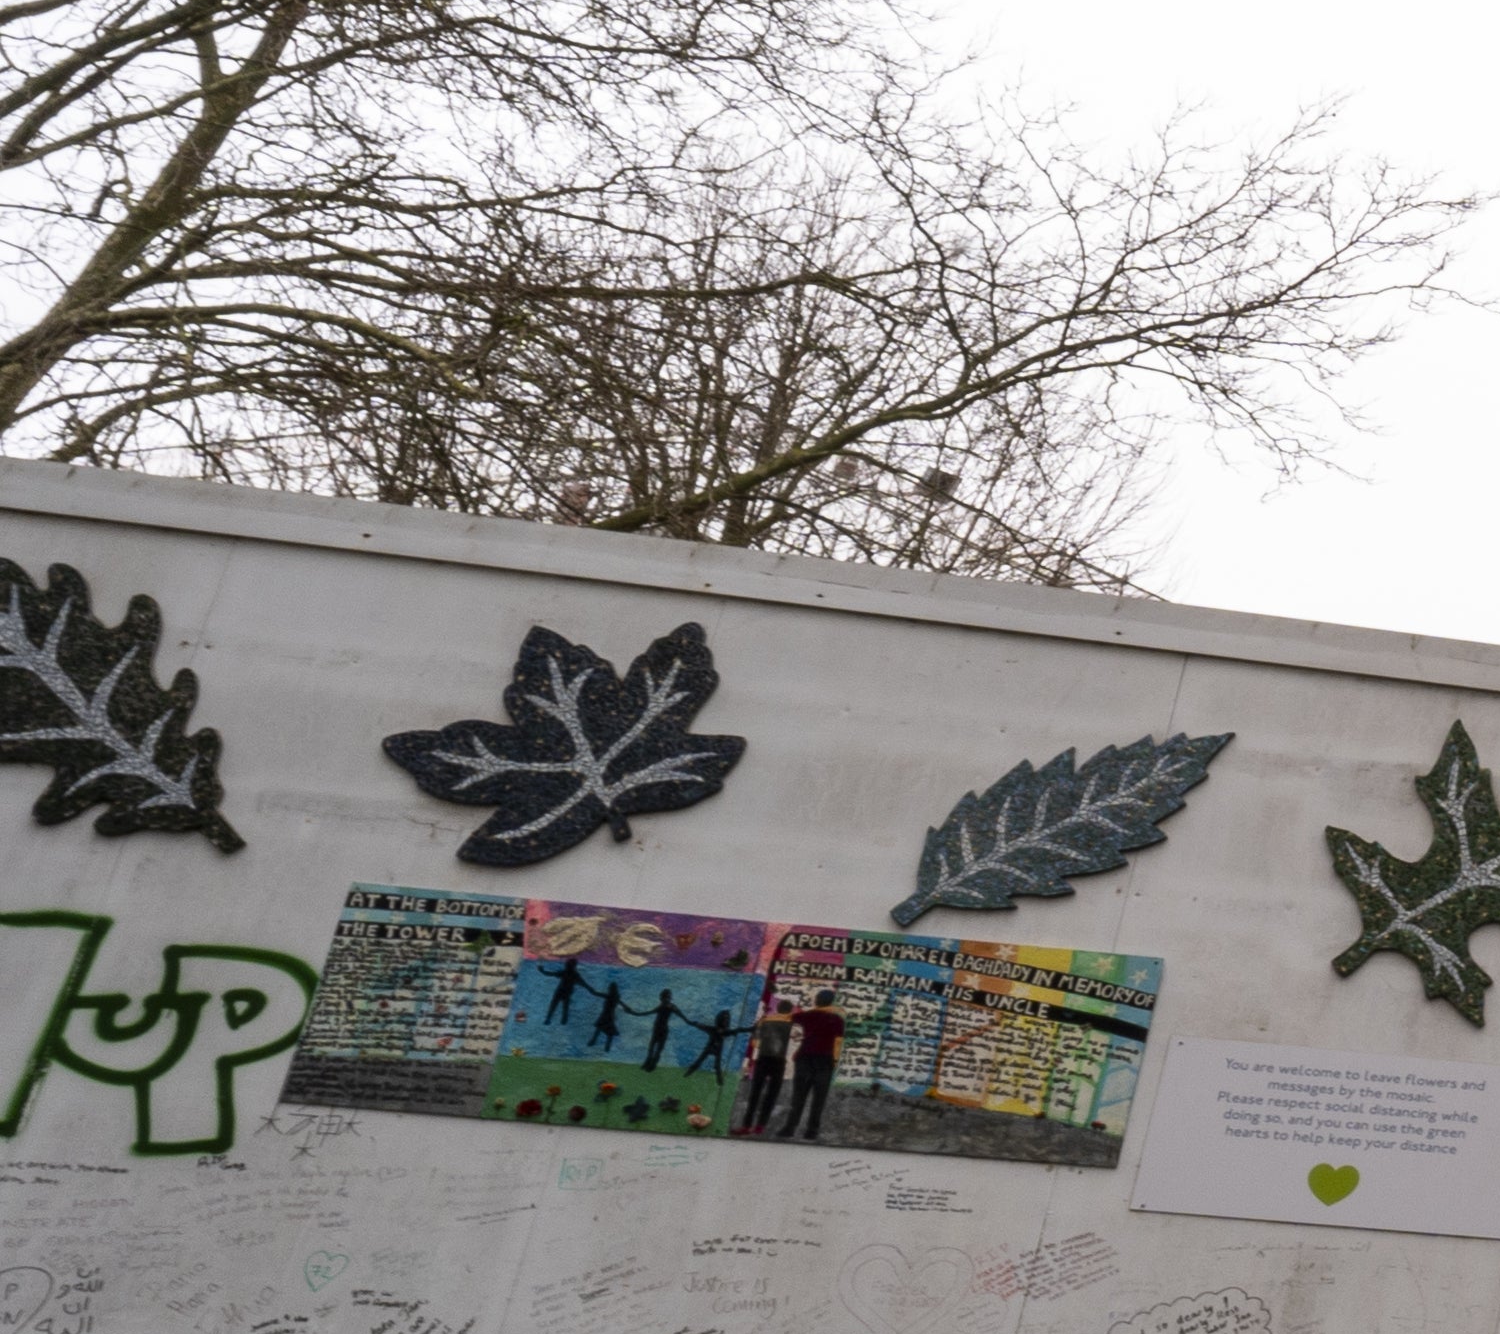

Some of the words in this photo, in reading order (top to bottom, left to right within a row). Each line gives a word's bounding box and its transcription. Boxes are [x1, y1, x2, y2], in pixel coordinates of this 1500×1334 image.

[350, 892, 381, 908] AT
[387, 895, 427, 912] THE
[436, 899, 507, 916] BOTTOM
[508, 905, 525, 918] OF
[340, 923, 378, 938] THE
[386, 925, 466, 942] TOWER
[798, 934, 848, 954] POEM
[852, 938, 879, 956] BY
[879, 942, 925, 963] OMAR
[952, 953, 1034, 986] BAGHDADY
[1033, 968, 1053, 987] IN
[1059, 974, 1134, 1005] MEMORY
[1133, 992, 1157, 1009] OF
[943, 984, 974, 1002] HIS
[985, 993, 1050, 1018] UNCLE
[1225, 1057, 1249, 1072] You
[1252, 1062, 1275, 1074] are
[1278, 1064, 1342, 1080] welcome
[1345, 1069, 1361, 1081] to
[1364, 1071, 1402, 1085] leave
[1405, 1074, 1457, 1089] flowers
[1461, 1079, 1486, 1092] and
[1267, 1080, 1335, 1098] messages
[1338, 1081, 1356, 1098] by
[1359, 1087, 1382, 1099] the
[1217, 1090, 1264, 1106] Please
[1267, 1096, 1321, 1113] respect
[1324, 1101, 1364, 1115] social
[1369, 1104, 1437, 1123] distancing
[1441, 1111, 1479, 1124] while
[1222, 1108, 1261, 1125] doing
[1288, 1114, 1313, 1127] and
[1316, 1118, 1342, 1133] you
[1345, 1119, 1369, 1131] can
[1372, 1123, 1397, 1134] use
[1401, 1123, 1423, 1136] the
[1427, 1127, 1466, 1140] green
[1224, 1126, 1269, 1140] hearts
[1273, 1129, 1289, 1141] to
[1292, 1130, 1324, 1146] help
[1328, 1133, 1361, 1149] keep
[1364, 1138, 1396, 1151] your
[1399, 1140, 1457, 1155] distance
